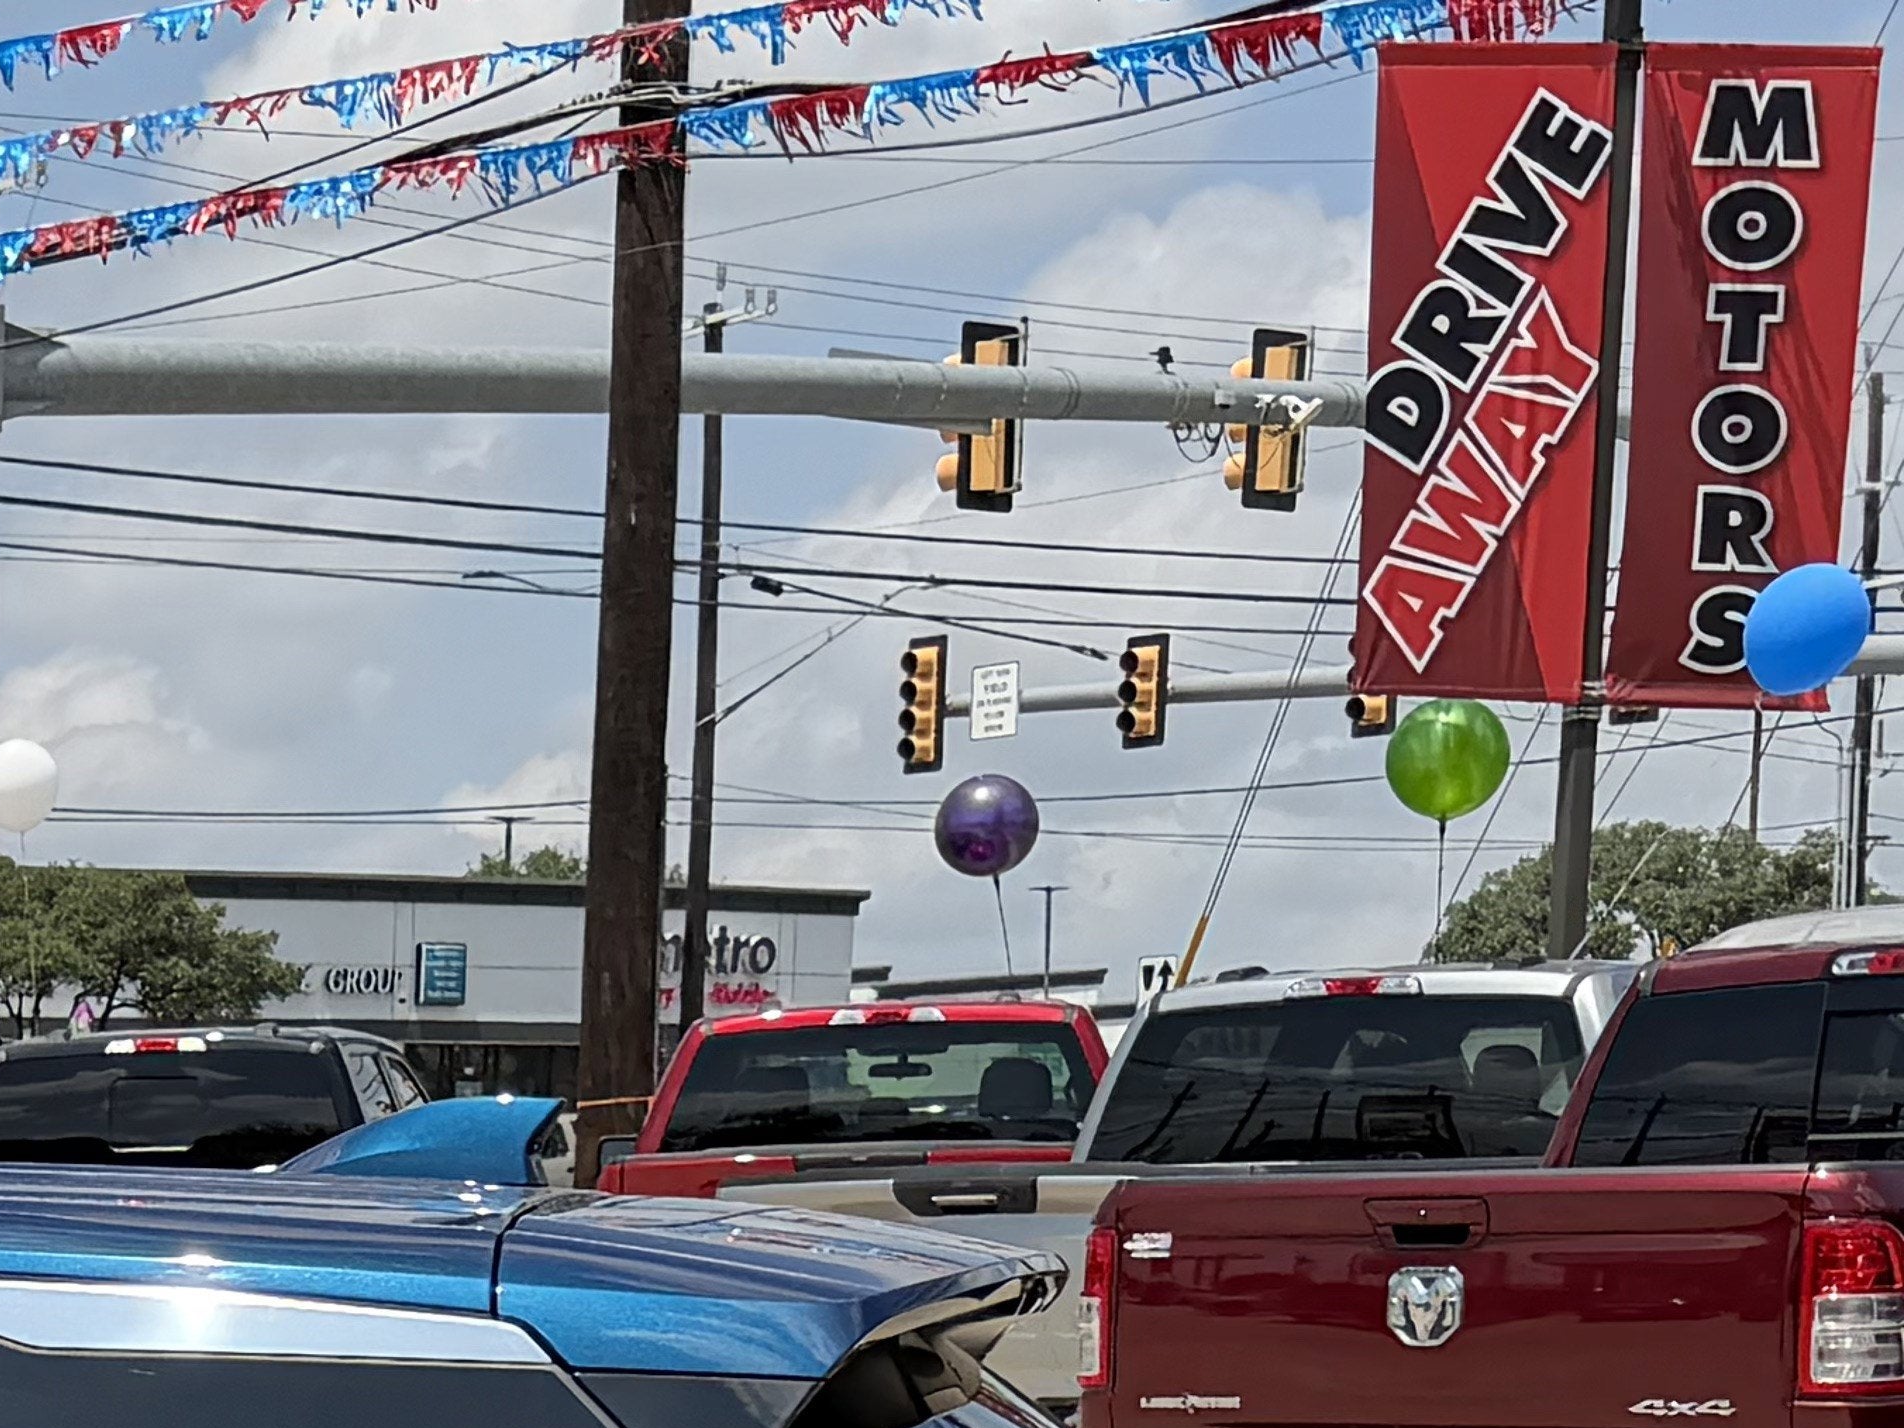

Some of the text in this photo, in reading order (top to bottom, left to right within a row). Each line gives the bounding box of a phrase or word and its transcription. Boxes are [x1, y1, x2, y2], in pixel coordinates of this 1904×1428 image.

[1364, 86, 1613, 475] DRIVE
[1678, 78, 1820, 675] MOTORS
[1362, 284, 1600, 674] AWAY
[325, 967, 404, 994] GROUP
